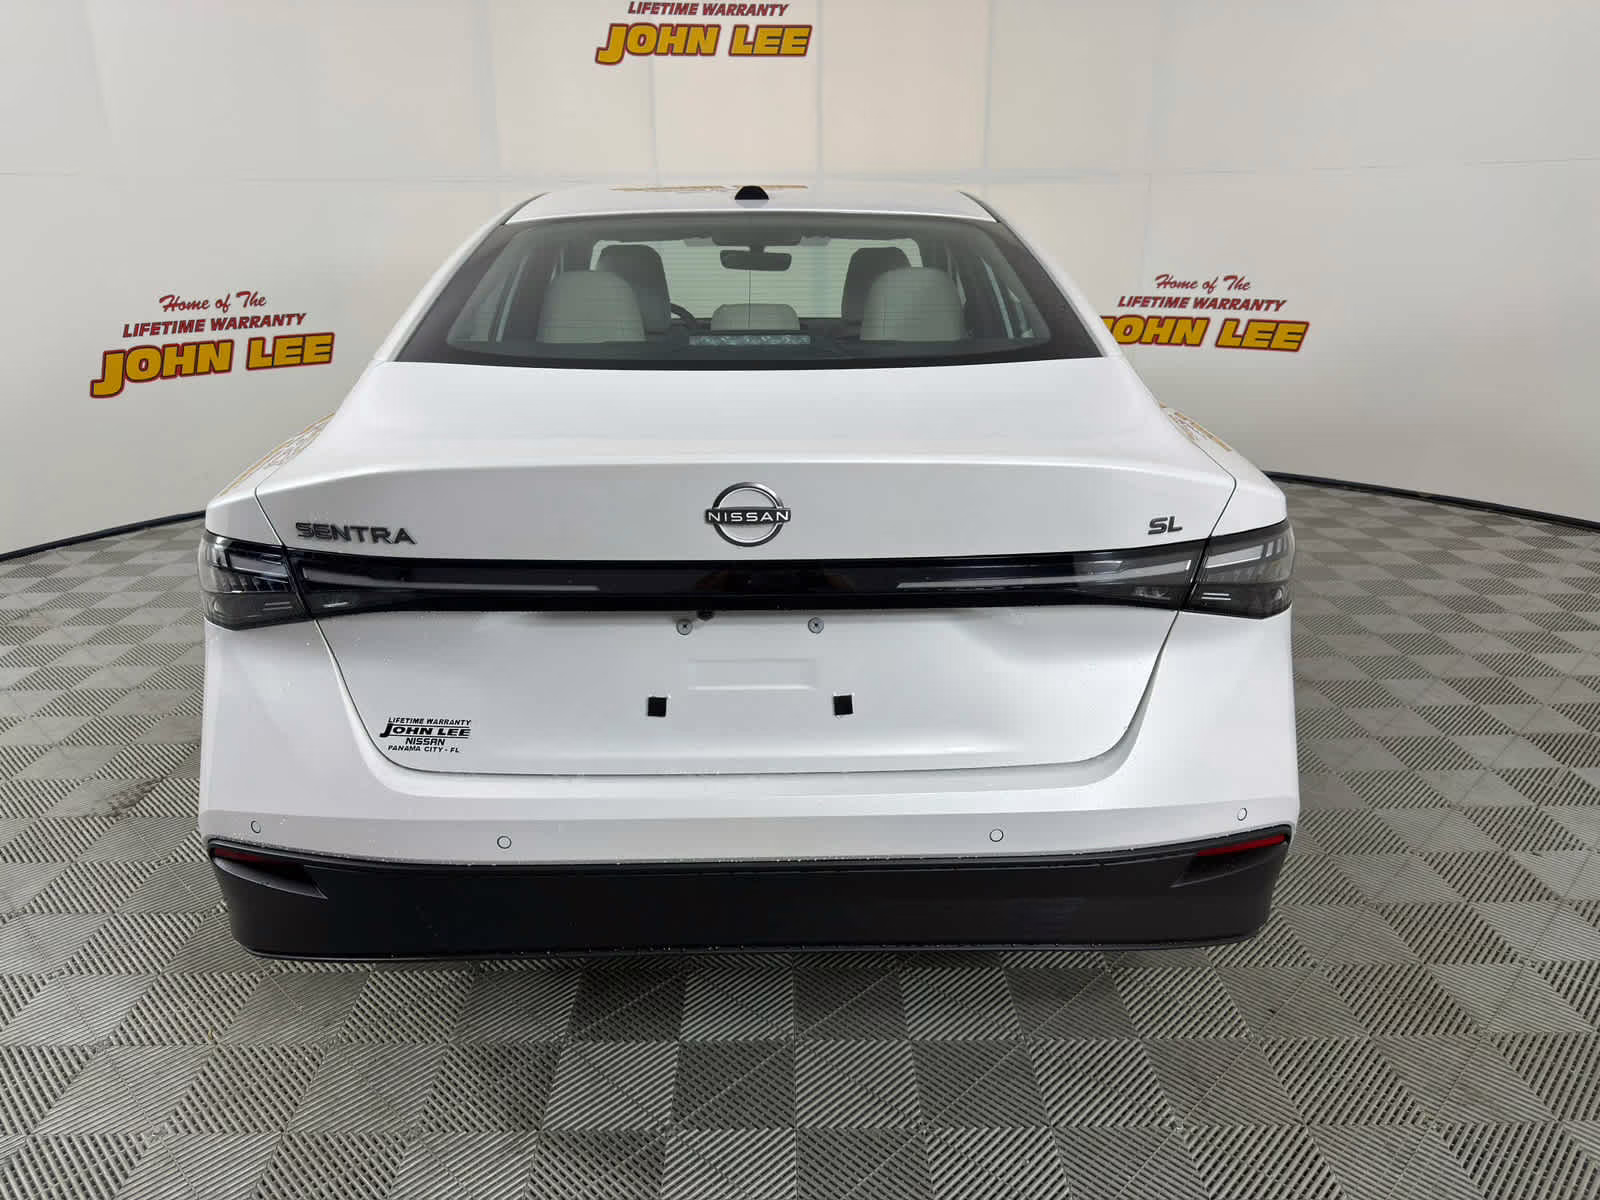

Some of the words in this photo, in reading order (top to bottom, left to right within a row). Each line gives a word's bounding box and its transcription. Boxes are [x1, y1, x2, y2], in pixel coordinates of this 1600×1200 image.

[628, 1, 699, 16] LIFETIME
[702, 2, 791, 17] WARRANTY
[595, 22, 721, 65] JOHN
[728, 24, 812, 57] LEE
[1154, 274, 1198, 289] Home
[1202, 276, 1219, 294] of
[1223, 275, 1251, 291] The
[159, 294, 210, 313] Home
[215, 293, 231, 313] of
[236, 291, 267, 308] The
[1117, 295, 1191, 309] LIFETIME
[1193, 297, 1287, 312] WARRANTY
[122, 318, 206, 338] LIFETIME
[210, 313, 307, 331] WARRANTY
[1215, 318, 1310, 352] LEE
[90, 339, 234, 398] JOHN
[245, 331, 335, 371] LEE
[708, 511, 789, 522] NISSAN
[1147, 515, 1183, 535] SL
[295, 522, 418, 544] SENTRA
[379, 723, 433, 738] JOHN
[437, 728, 472, 737] LEE
[388, 717, 425, 725] LIFETIME
[426, 718, 472, 726] WARRANTY
[405, 738, 446, 746] NISSAN
